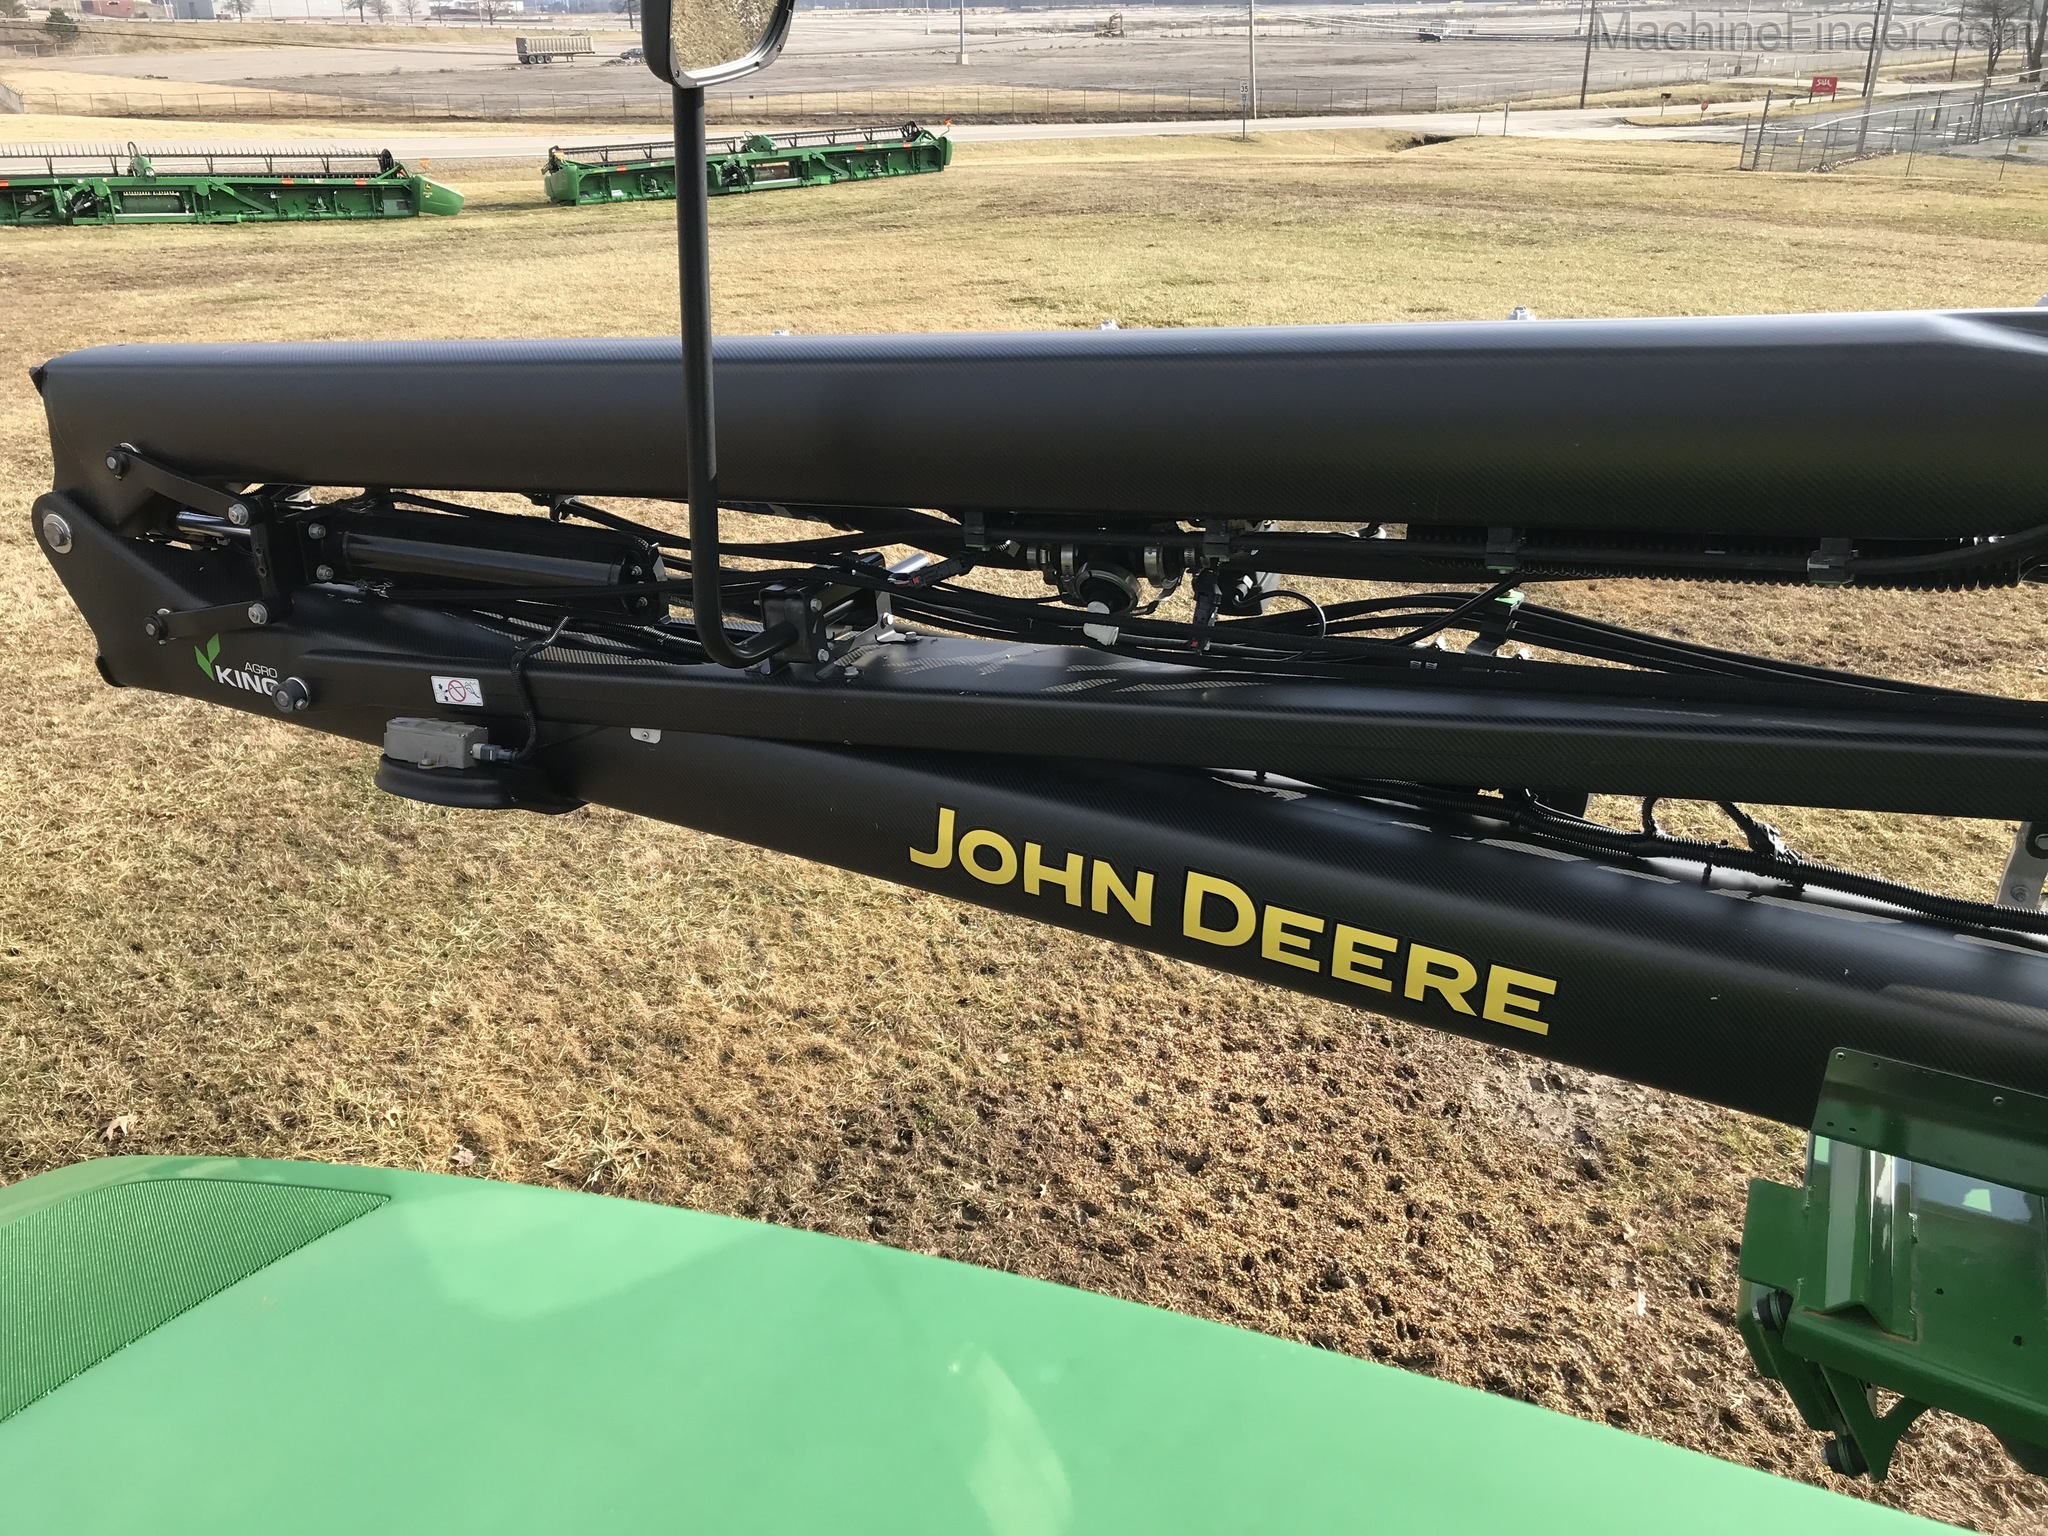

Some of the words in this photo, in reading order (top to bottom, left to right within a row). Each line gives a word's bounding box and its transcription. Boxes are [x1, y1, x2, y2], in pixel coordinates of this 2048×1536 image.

[244, 662, 278, 678] AGRO
[909, 807, 1155, 926] JOHN
[1182, 870, 1558, 1037] DEERE
